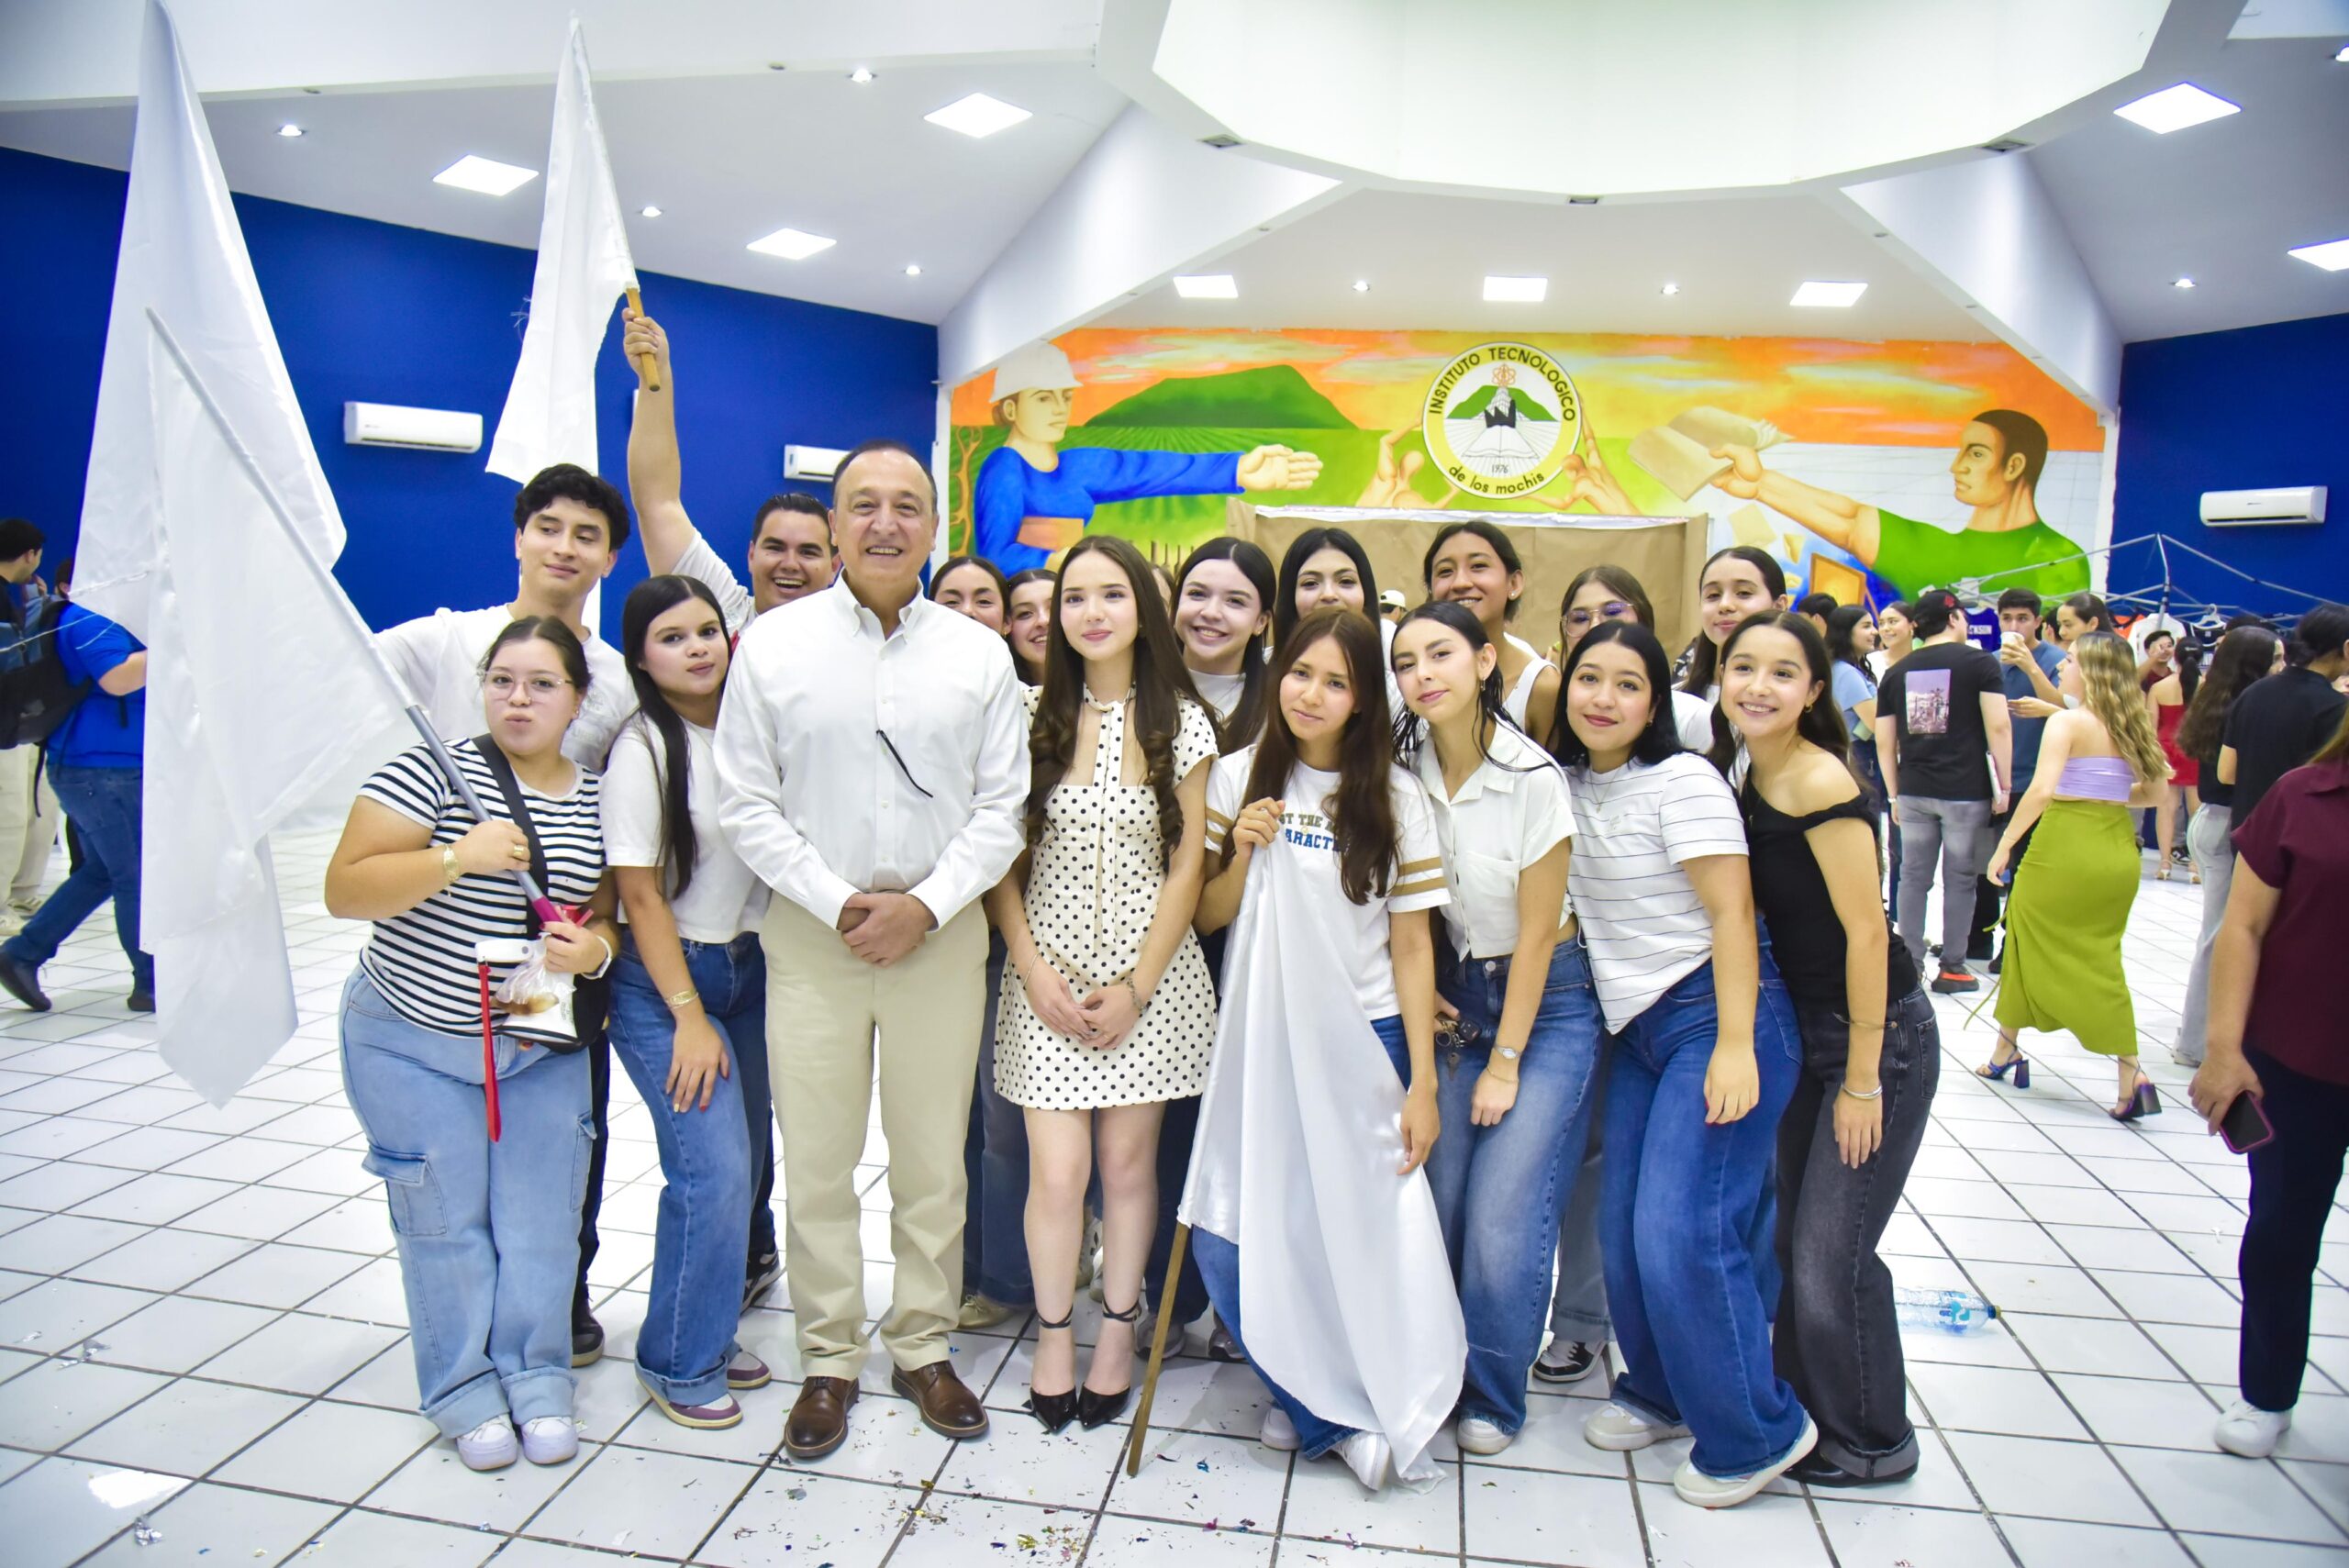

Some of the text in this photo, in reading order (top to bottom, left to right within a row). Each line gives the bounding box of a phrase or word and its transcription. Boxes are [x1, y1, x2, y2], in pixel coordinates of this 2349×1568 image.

[1430, 347, 1575, 421] INSTITUTO TECNOLOGICO
[1491, 464, 1509, 473] 1976
[1449, 465, 1544, 494] de los mochis
[1298, 814, 1323, 828] THE
